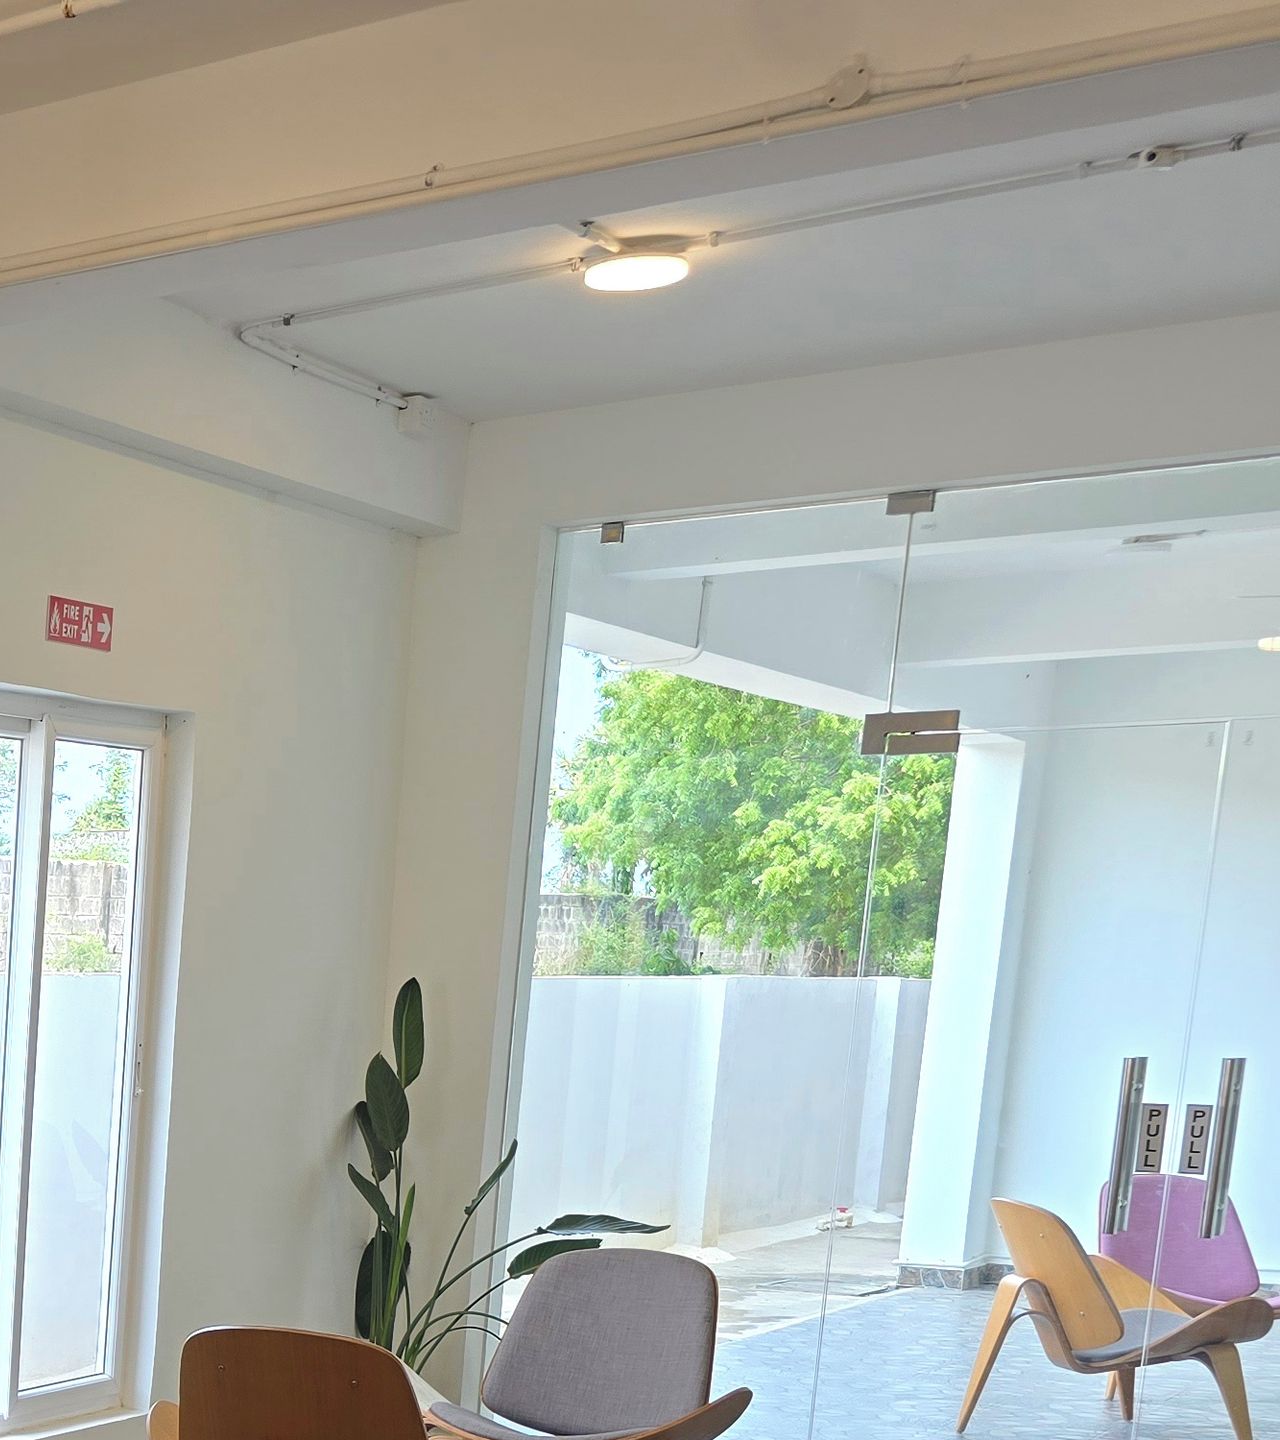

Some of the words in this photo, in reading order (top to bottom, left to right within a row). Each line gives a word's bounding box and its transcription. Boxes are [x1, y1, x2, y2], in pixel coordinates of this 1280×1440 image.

[63, 604, 80, 620] FIRE
[62, 623, 78, 639] EXIT
[1143, 1109, 1161, 1168] PULL
[1187, 1110, 1206, 1169] PULL
